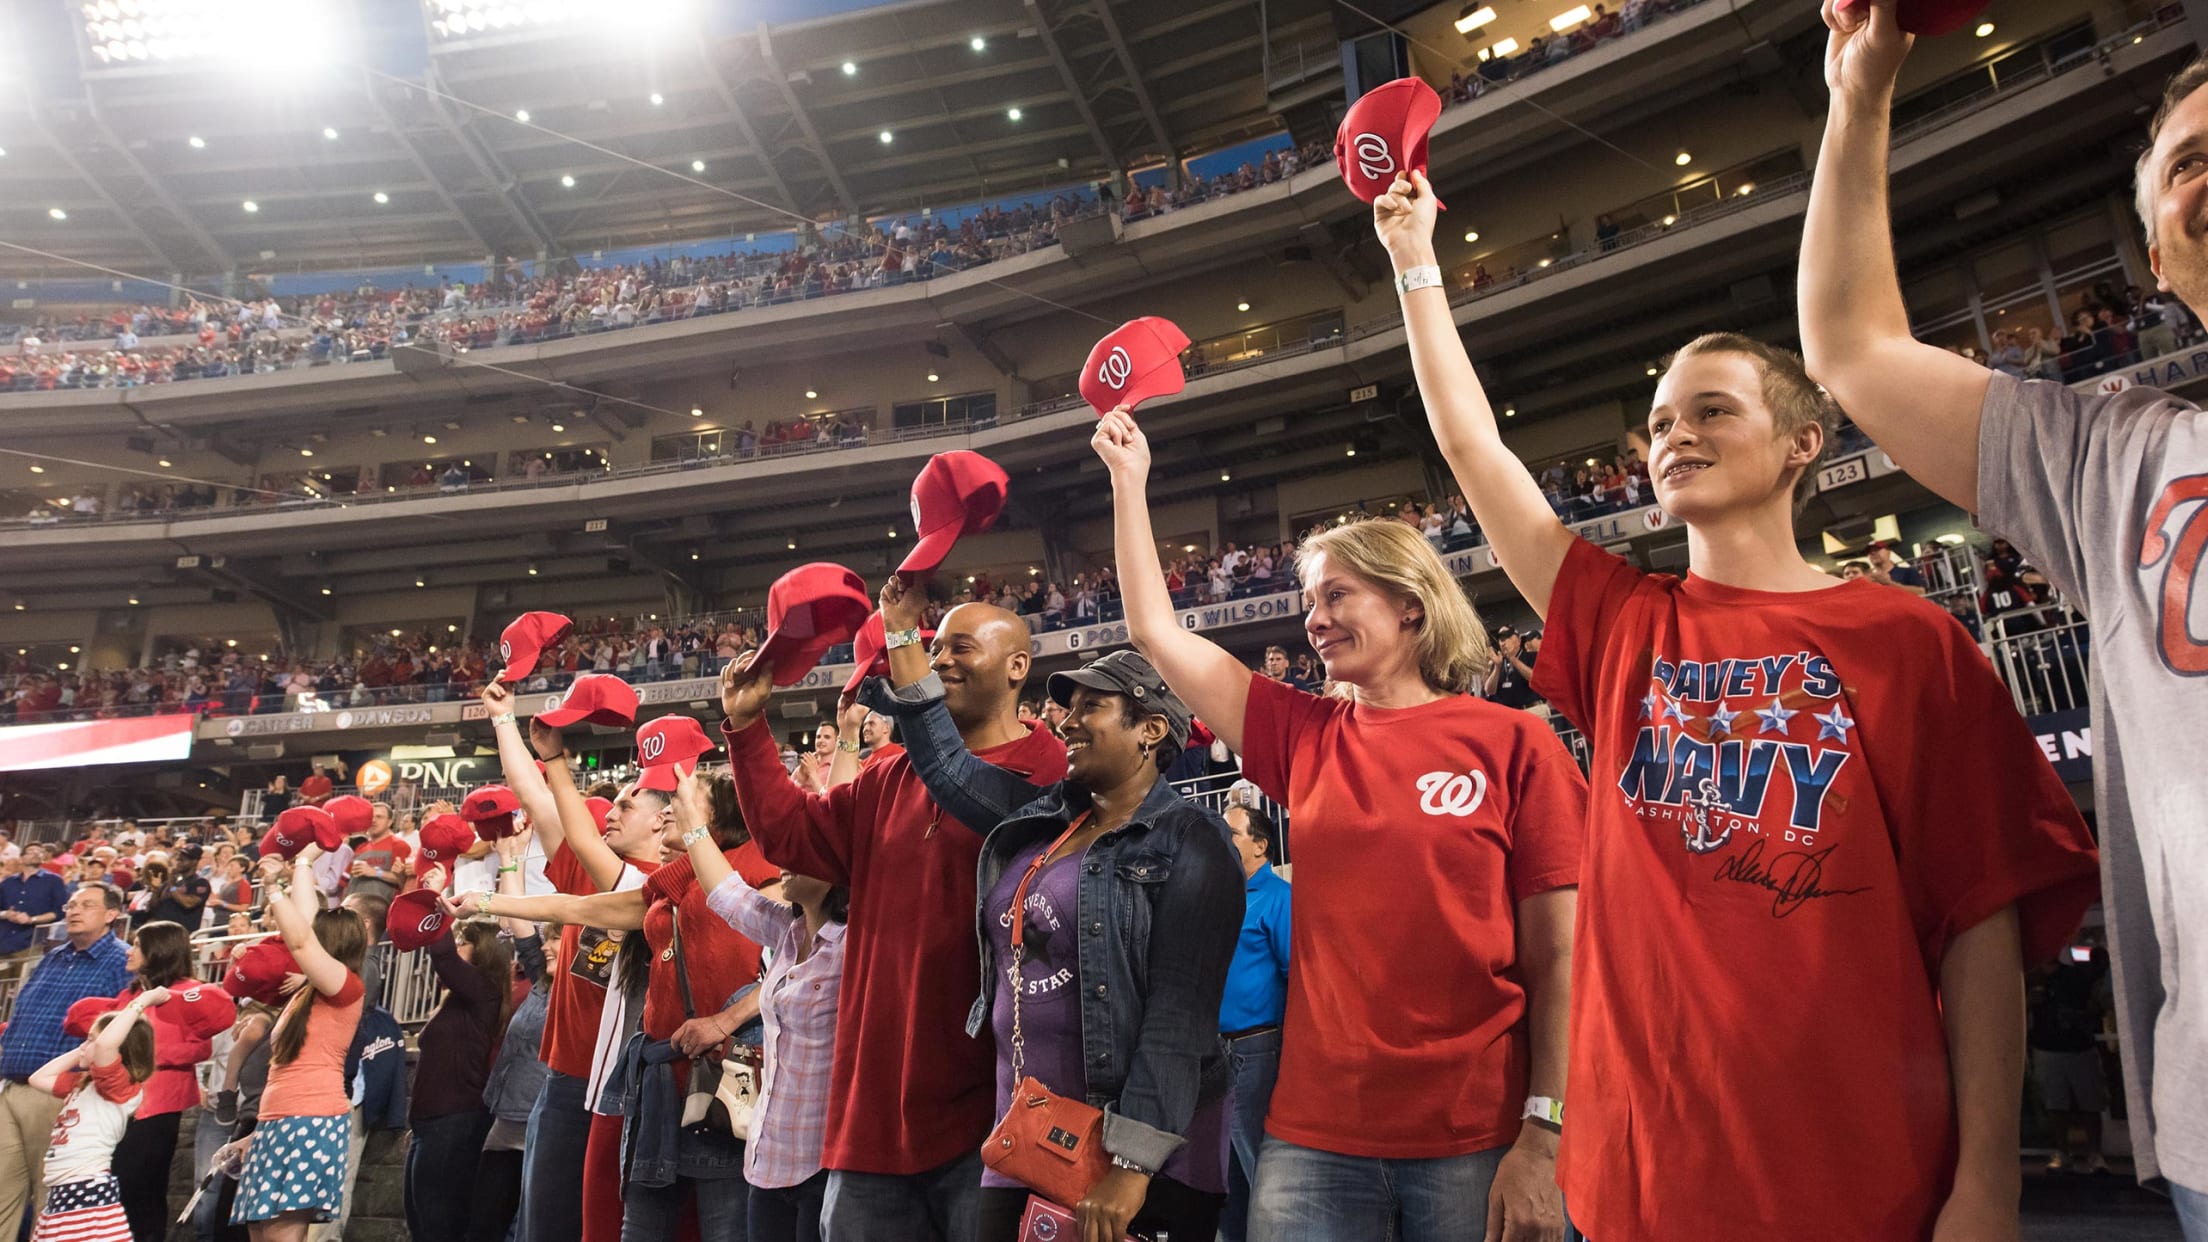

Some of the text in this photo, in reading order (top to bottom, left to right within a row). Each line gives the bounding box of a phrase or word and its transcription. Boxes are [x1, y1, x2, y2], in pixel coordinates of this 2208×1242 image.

[2135, 351, 2208, 386] HAR
[1825, 465, 1858, 486] 123
[1648, 511, 1662, 527] W
[1992, 591, 2012, 609] 10
[1186, 598, 1290, 629] G WILSON
[1070, 633, 1079, 648] G
[650, 682, 717, 701] BROWN
[352, 708, 433, 725] DAWSON
[468, 707, 486, 718] 126
[398, 759, 476, 789] PNC
[1618, 725, 1850, 832] NAVY
[1416, 769, 1487, 817] W
[1784, 829, 1814, 846] DC
[1000, 893, 1061, 931] CNVERSE
[1028, 967, 1074, 994] STAR
